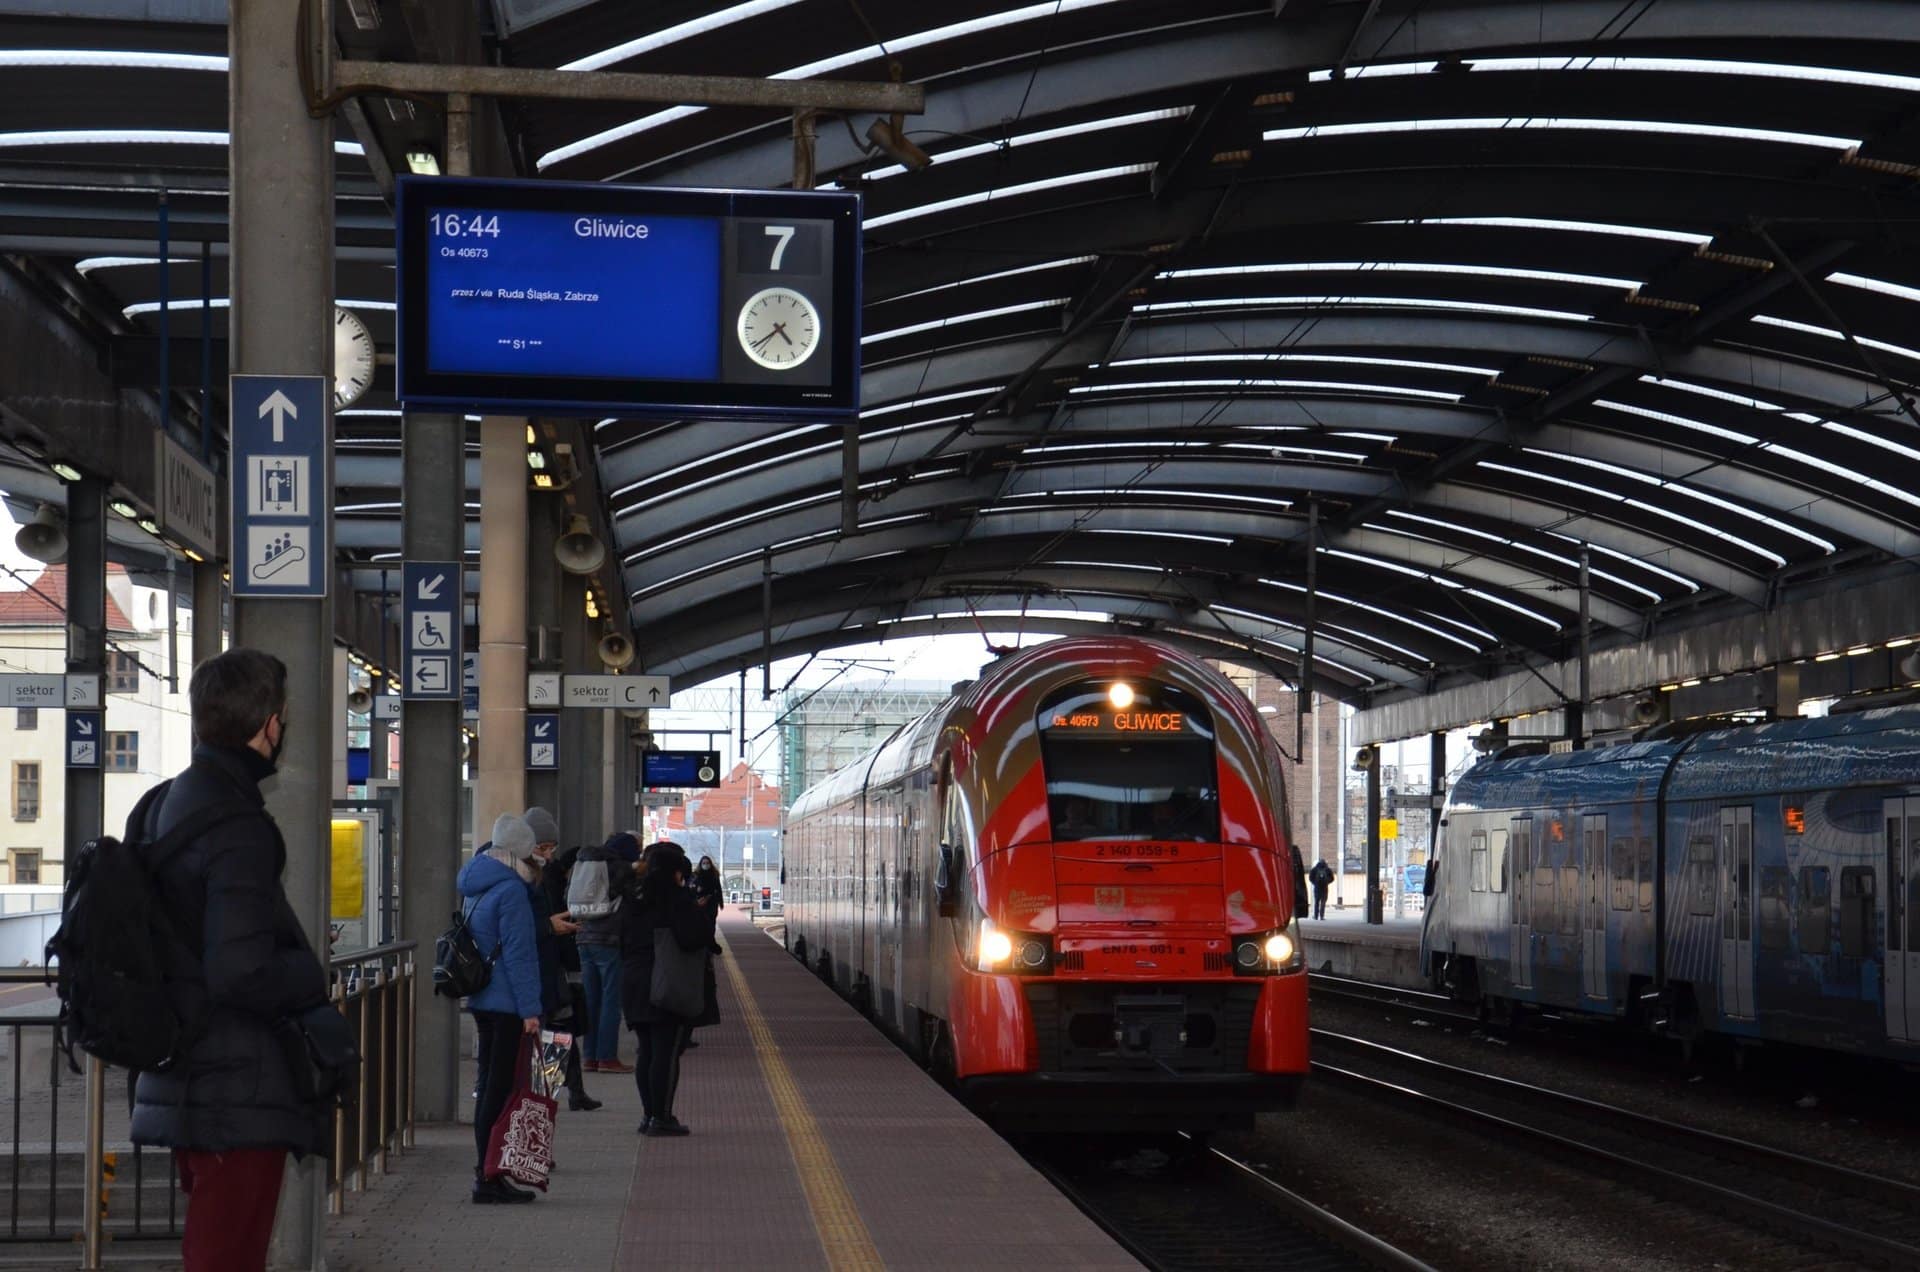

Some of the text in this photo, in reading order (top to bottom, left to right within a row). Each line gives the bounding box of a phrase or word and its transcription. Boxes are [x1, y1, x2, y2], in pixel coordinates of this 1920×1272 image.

[430, 213, 649, 239] 16:44 Gliwice
[440, 246, 489, 259] Os 40673
[764, 226, 796, 271] 7
[451, 288, 474, 297] przez
[498, 288, 525, 299] Ruda
[526, 288, 562, 301] Śląska,
[564, 291, 599, 302] Zabrze
[513, 339, 526, 350] S1
[15, 685, 55, 696] sektor
[572, 684, 636, 702] sektor C
[1113, 713, 1182, 731] GLIWICE
[704, 756, 710, 765] 7
[1095, 845, 1105, 857] 2
[1110, 845, 1132, 857] 140
